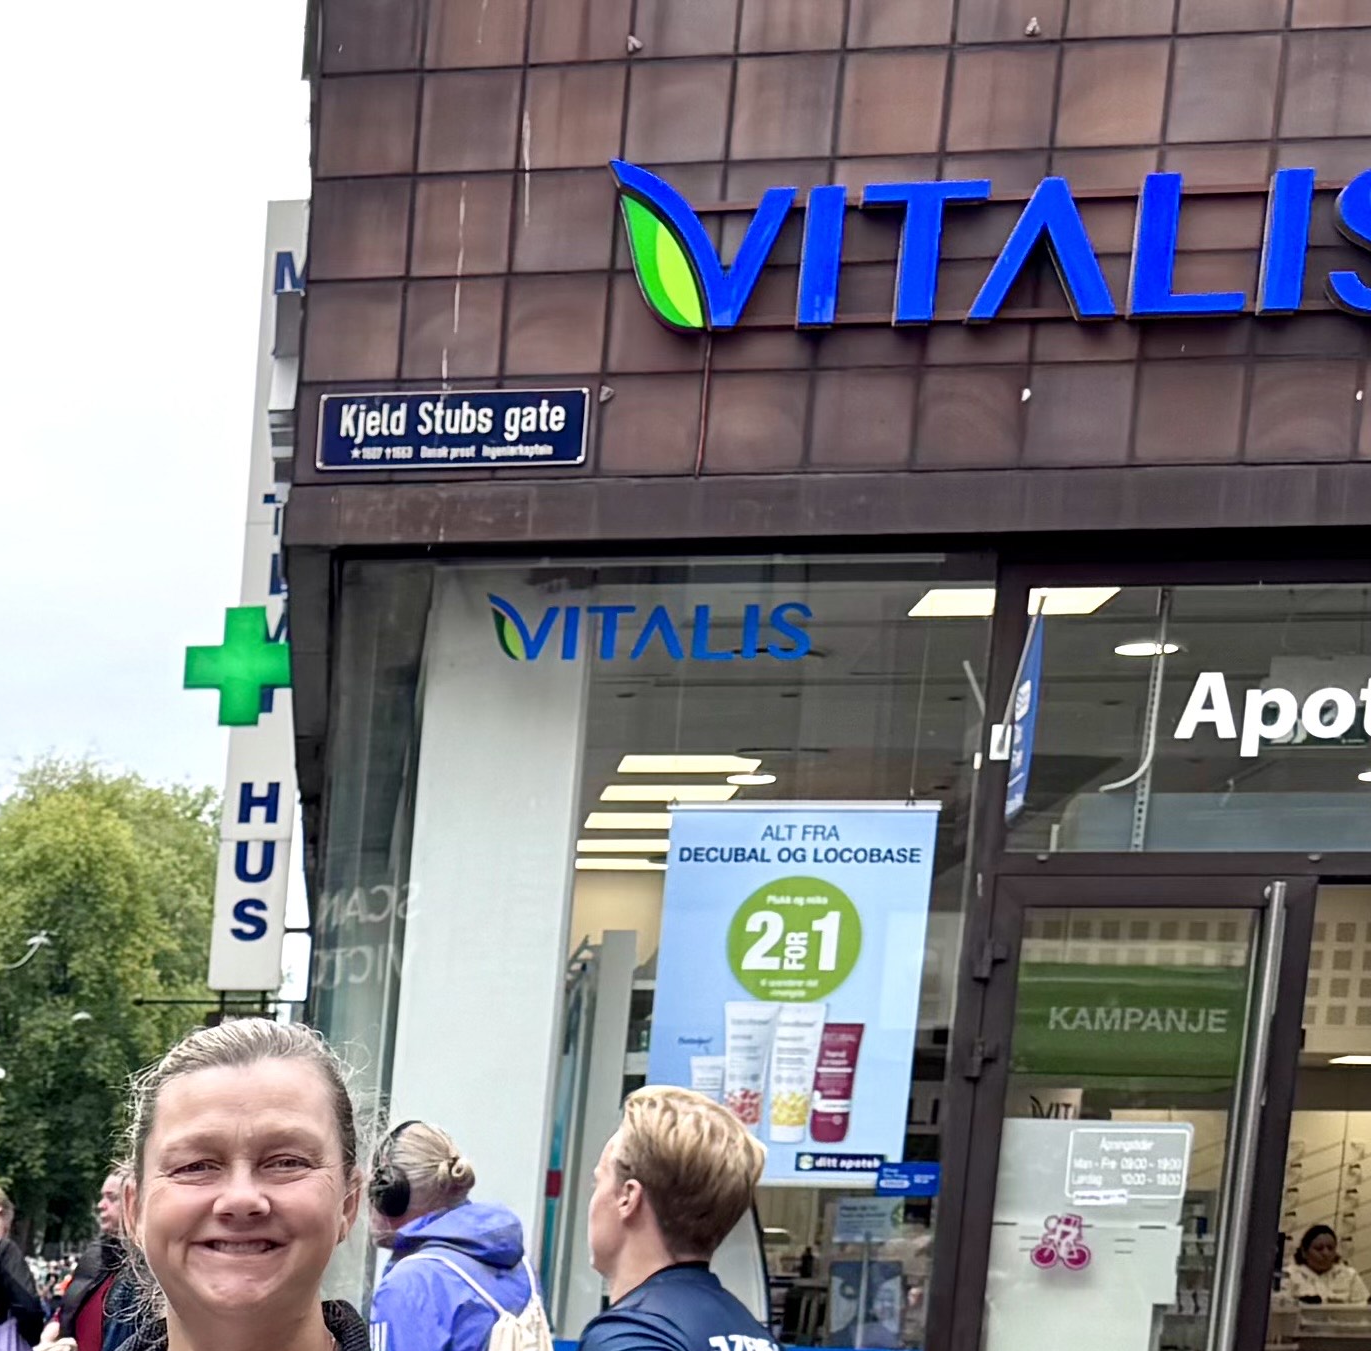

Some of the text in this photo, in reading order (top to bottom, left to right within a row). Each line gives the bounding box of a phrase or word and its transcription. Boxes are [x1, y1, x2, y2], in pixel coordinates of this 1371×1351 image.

[339, 399, 566, 444] Kjeld Stubs gate
[487, 592, 813, 662] VITALIS
[761, 825, 840, 842] ALT FRA
[679, 847, 922, 864] DECUBAL OG LOCOBASE
[741, 910, 841, 971] 2 FOR 1
[1048, 1005, 1230, 1034] KAMPANJE
